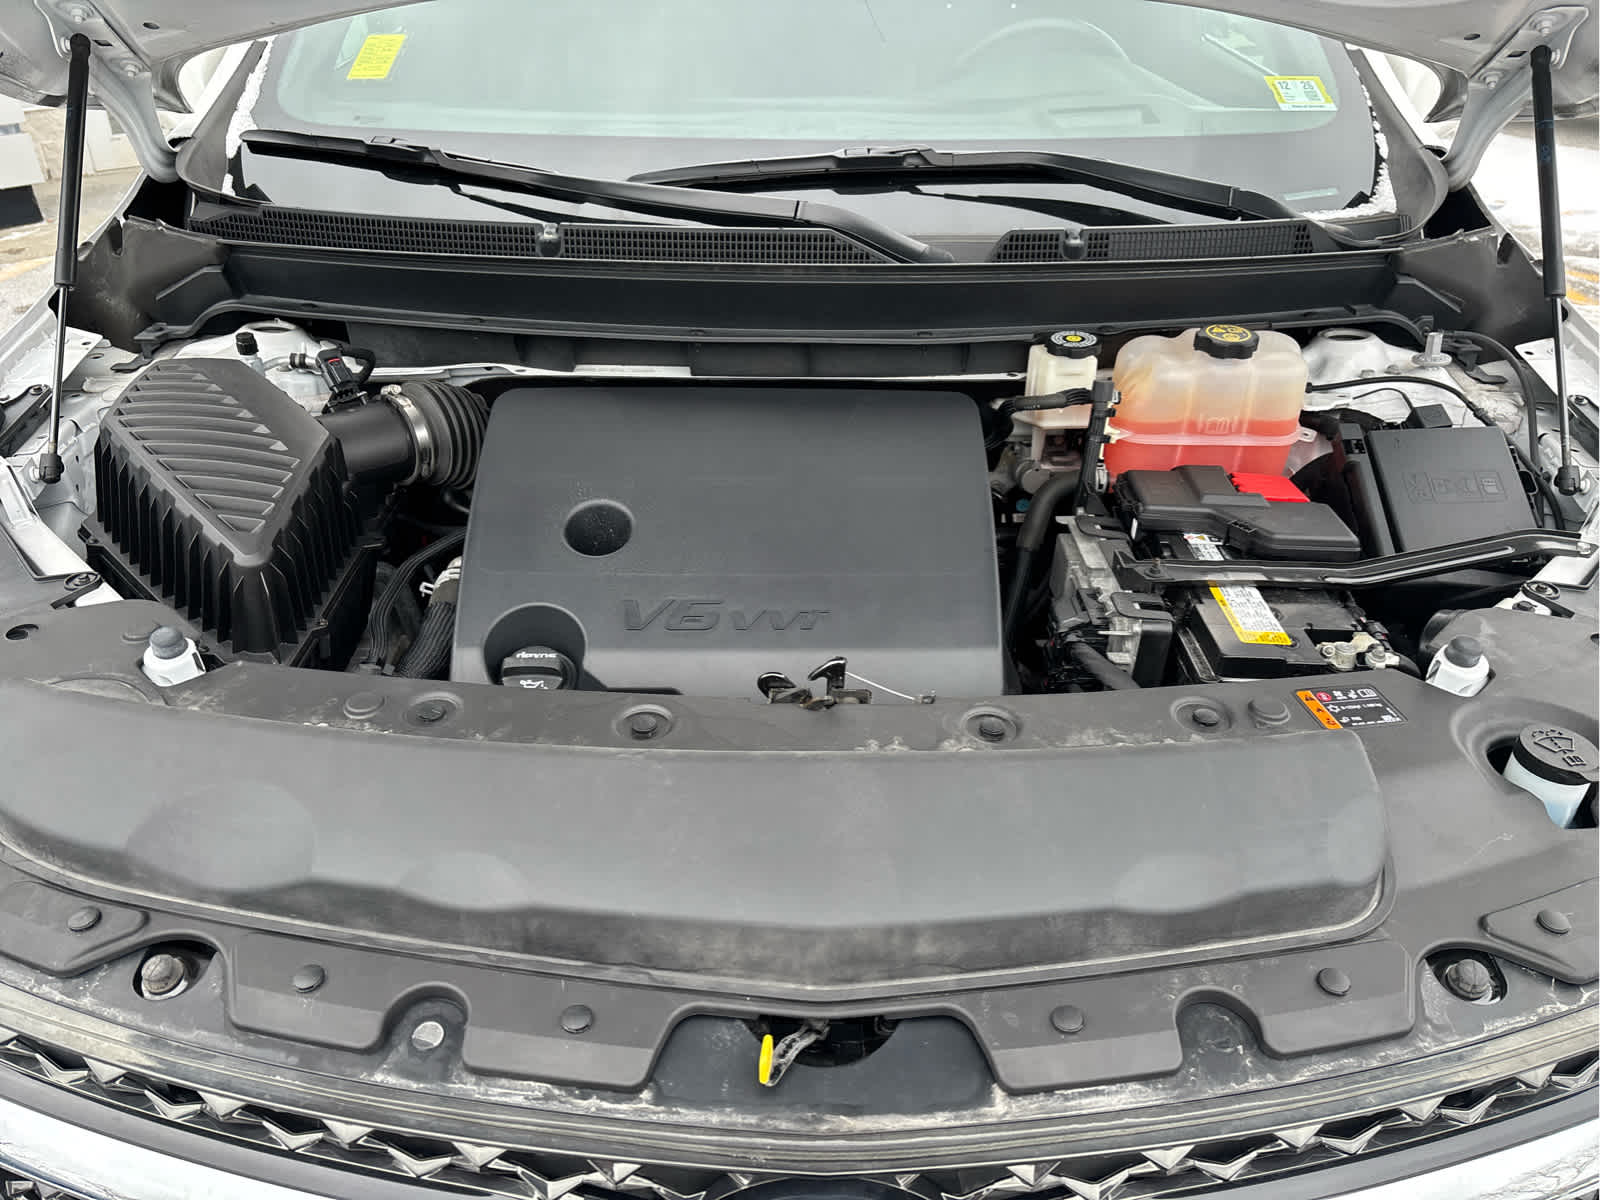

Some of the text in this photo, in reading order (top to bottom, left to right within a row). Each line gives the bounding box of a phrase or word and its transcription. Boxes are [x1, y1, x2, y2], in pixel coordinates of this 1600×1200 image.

[1277, 80, 1291, 90] 12
[623, 598, 833, 632] V6 VVT
